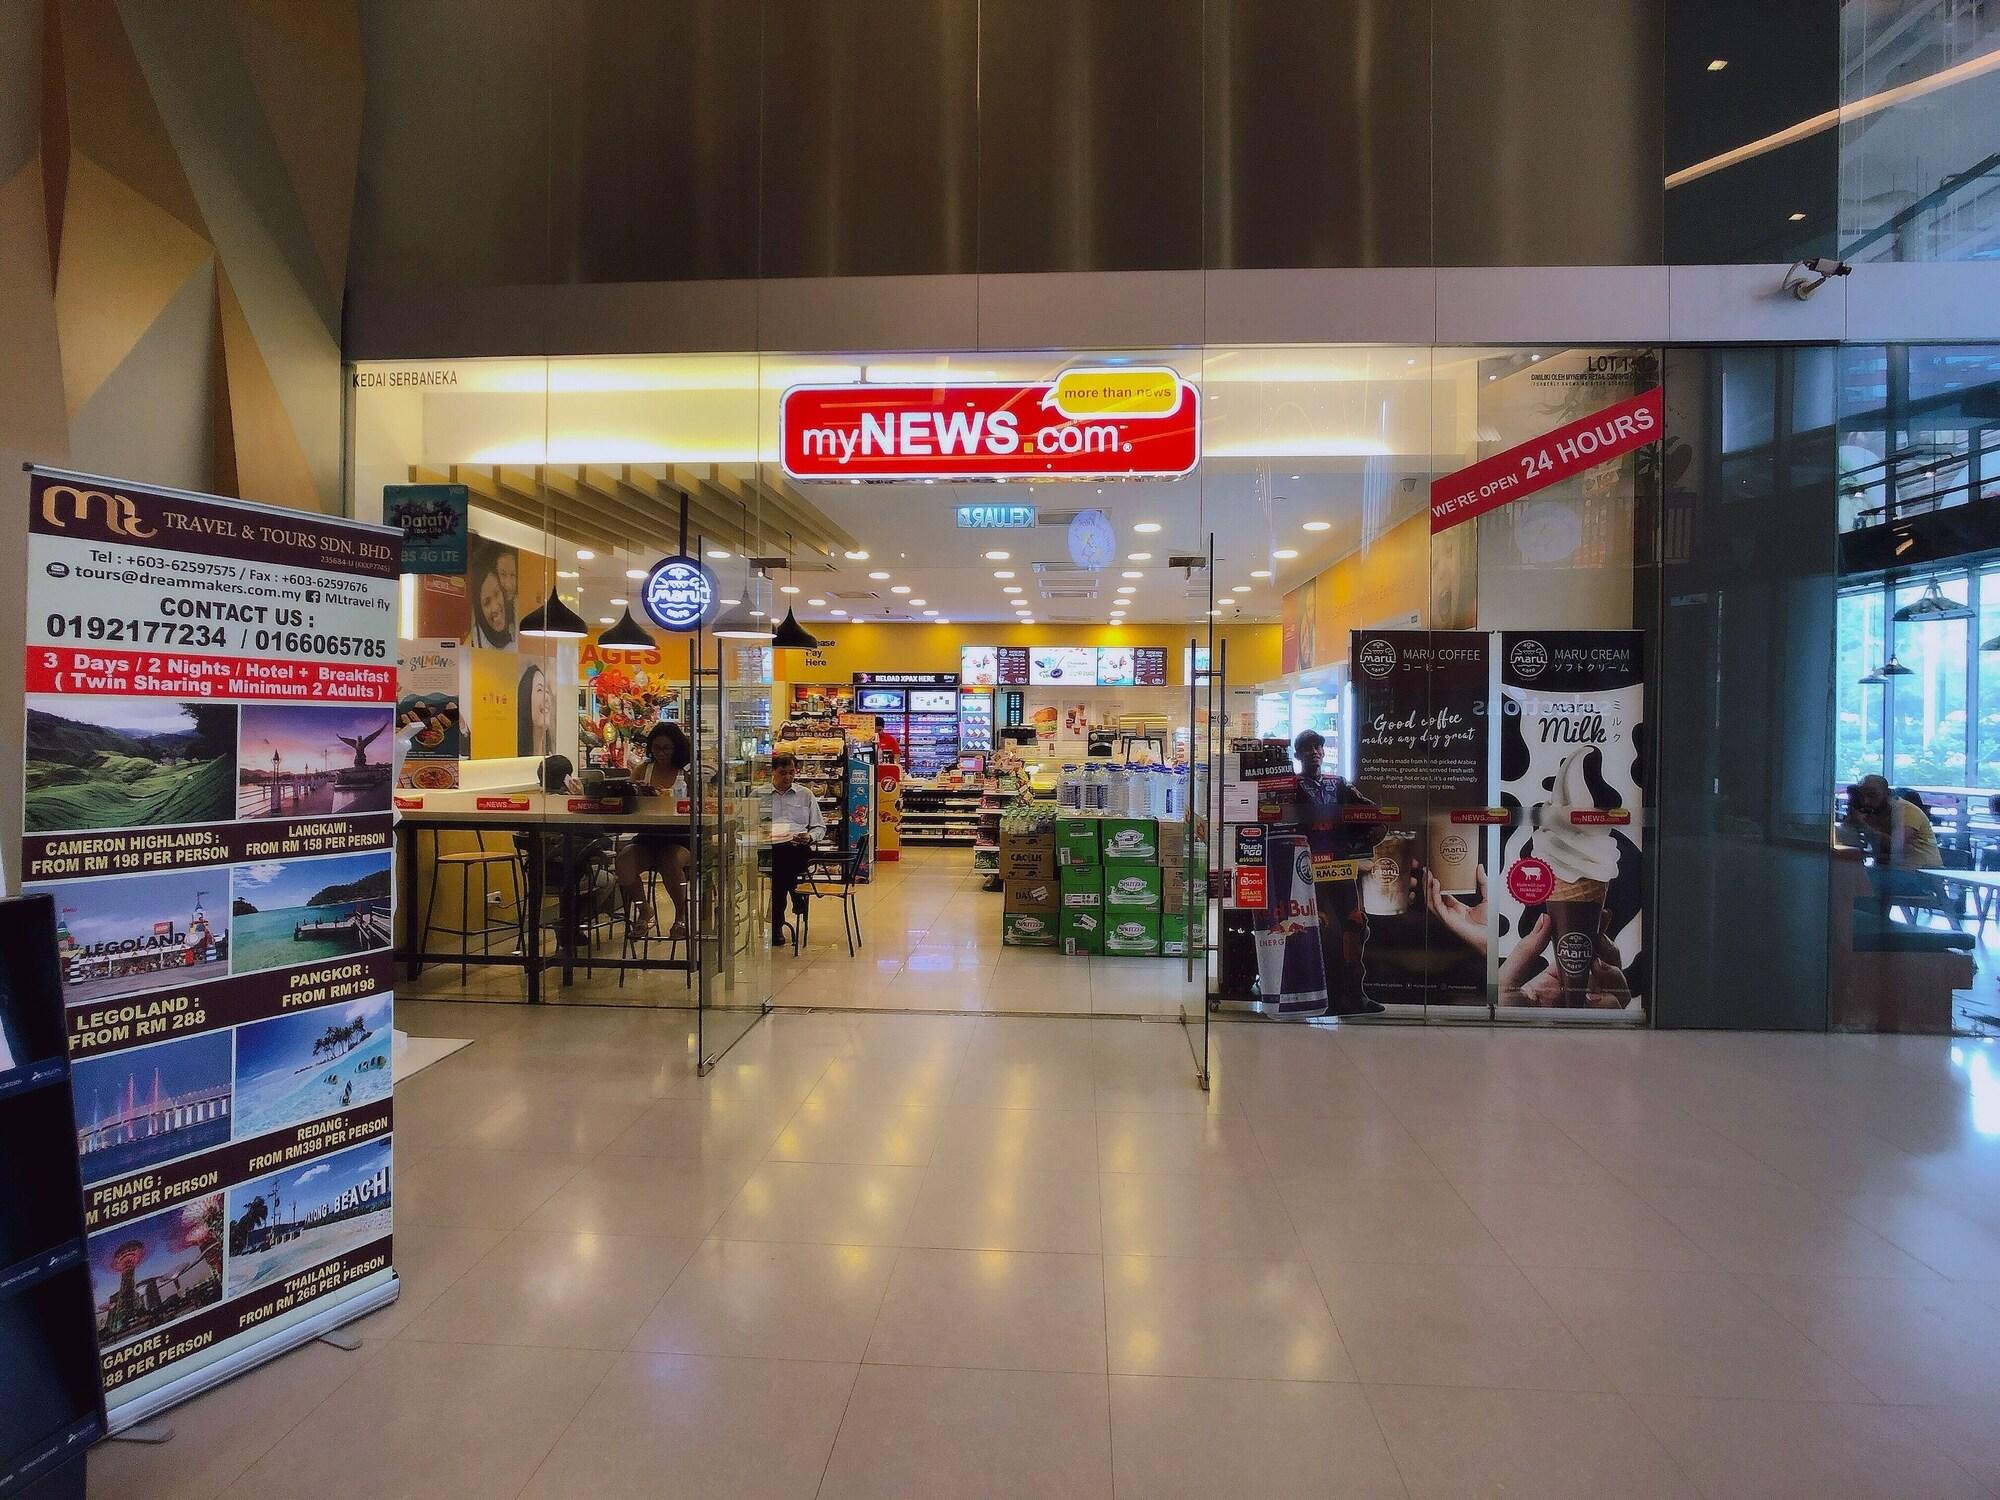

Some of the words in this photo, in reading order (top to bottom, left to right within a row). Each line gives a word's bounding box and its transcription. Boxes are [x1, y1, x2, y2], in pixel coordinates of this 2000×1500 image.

[352, 373, 386, 388] KEDAI
[389, 371, 458, 386] SERBANEKA
[1064, 388, 1099, 399] more
[1103, 387, 1132, 398] than
[1136, 388, 1172, 397] news
[1520, 449, 1554, 480] 24
[1555, 407, 1655, 464] HOURS
[1479, 473, 1519, 498] OPEN
[401, 512, 453, 529] Datafy
[162, 511, 236, 537] TRAVEL
[241, 524, 255, 541] &
[259, 526, 317, 549] TOURS
[320, 536, 355, 555] SDN.
[359, 542, 394, 561] BHD.
[419, 550, 437, 562] 4G
[440, 550, 460, 562] LTE
[88, 550, 112, 563] Tel
[126, 556, 236, 578] +603-62597575
[250, 569, 271, 583] Fax
[282, 574, 368, 593] +603-62597676
[75, 565, 301, 601] tours@dreammakers.com.my
[377, 598, 391, 612] fly
[160, 597, 268, 624] CONTACT
[275, 608, 303, 627] US
[46, 613, 227, 647] 0192177234
[255, 629, 386, 658] 0166065785
[409, 655, 448, 672] SALMON
[805, 659, 827, 667] Here
[1359, 655, 1397, 663] maru
[1402, 649, 1435, 660] MARU
[1438, 649, 1481, 660] COFFEE
[1510, 655, 1548, 664] maru
[1554, 649, 1588, 660] MARU
[1590, 649, 1630, 660] CREAM
[43, 652, 58, 669] 3
[74, 653, 129, 674] Days
[149, 657, 161, 673] 2
[167, 659, 231, 677] Nights
[246, 663, 293, 679] Hotel
[299, 667, 309, 677] +
[318, 667, 390, 683] Breakfast
[875, 675, 900, 683] RELOAD
[900, 675, 919, 683] XPAX
[919, 675, 936, 683] HERE
[1554, 663, 1630, 672] ソフトクリーム
[70, 672, 127, 689] Twin
[134, 675, 212, 696] Sharing
[228, 678, 308, 695] Minimum
[312, 682, 322, 696] 2
[327, 682, 374, 698] Adults
[1373, 709, 1417, 732] Good
[1420, 706, 1463, 730] coffee
[1538, 715, 1607, 743] Milk
[1361, 731, 1394, 745] makes
[1397, 734, 1417, 749] any
[1444, 727, 1476, 748] great
[1245, 767, 1264, 777] MAJU
[288, 822, 347, 838] LANGKAWI
[45, 838, 126, 856] CAMERON
[130, 832, 213, 850] HIGHLANDS
[246, 842, 279, 855] FROM
[282, 840, 300, 852] RM
[303, 838, 322, 850] 158
[325, 837, 346, 848] PER
[348, 833, 385, 847] PERSON
[31, 858, 80, 874] FROM
[84, 856, 109, 870] RM
[113, 853, 140, 868] 198
[143, 850, 172, 865] PER
[176, 846, 229, 863] PERSON
[1316, 867, 1353, 878] RM6.30
[1289, 897, 1317, 917] Bull
[290, 964, 362, 988] PANGKOR
[282, 987, 326, 1008] FROM
[330, 978, 376, 998] RM198
[76, 997, 189, 1030] LEGOLAND
[68, 1025, 130, 1050] FROM
[136, 1018, 167, 1036] RM
[172, 1010, 206, 1030] 288
[297, 1119, 343, 1142] REDANG
[248, 1152, 282, 1172] FROM
[285, 1139, 323, 1161] RM398
[324, 1132, 346, 1152] PER
[349, 1116, 388, 1140] PERSON
[92, 1177, 155, 1207] PENANG
[103, 1199, 129, 1219] 158
[132, 1191, 161, 1211] PER
[164, 1171, 218, 1200] PERSON
[333, 1166, 390, 1214] BEACH
[284, 1262, 340, 1294] THAILAND
[239, 1306, 273, 1327] FROM
[276, 1297, 293, 1315] RM
[297, 1285, 317, 1303] 268
[319, 1274, 341, 1295] PER
[343, 1255, 385, 1281] PERSON
[101, 1334, 161, 1370] GAPORE
[102, 1370, 123, 1389] 88
[127, 1357, 155, 1378] PER
[159, 1330, 213, 1364] PERSON
